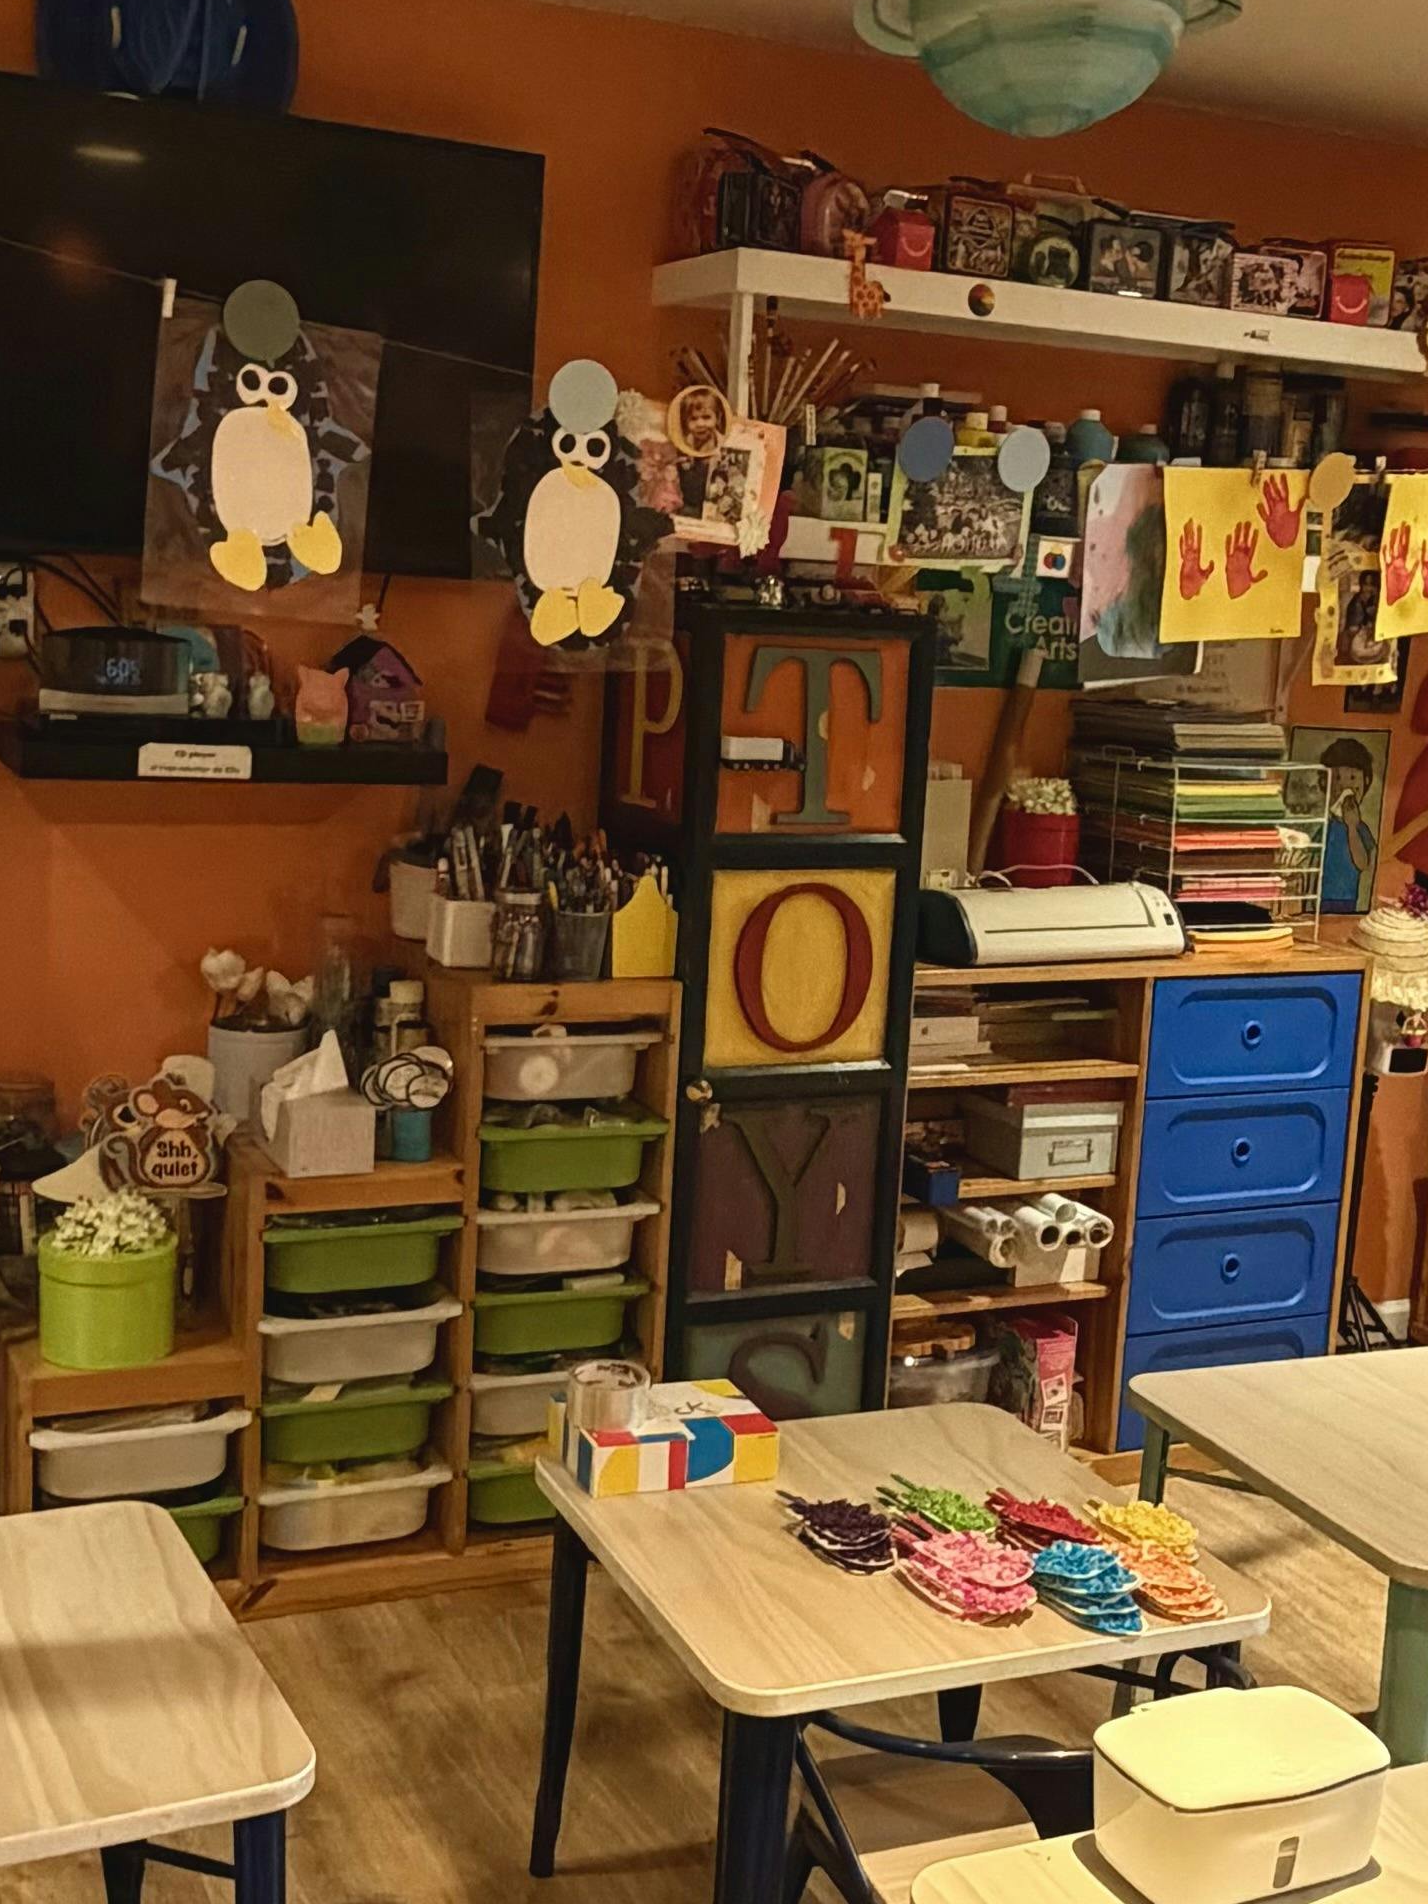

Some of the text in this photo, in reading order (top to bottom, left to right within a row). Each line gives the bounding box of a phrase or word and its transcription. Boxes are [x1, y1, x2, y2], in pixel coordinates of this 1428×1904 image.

[1036, 636, 1078, 661] Arts
[156, 1140, 199, 1159] Shh,
[151, 1160, 198, 1179] quiet
